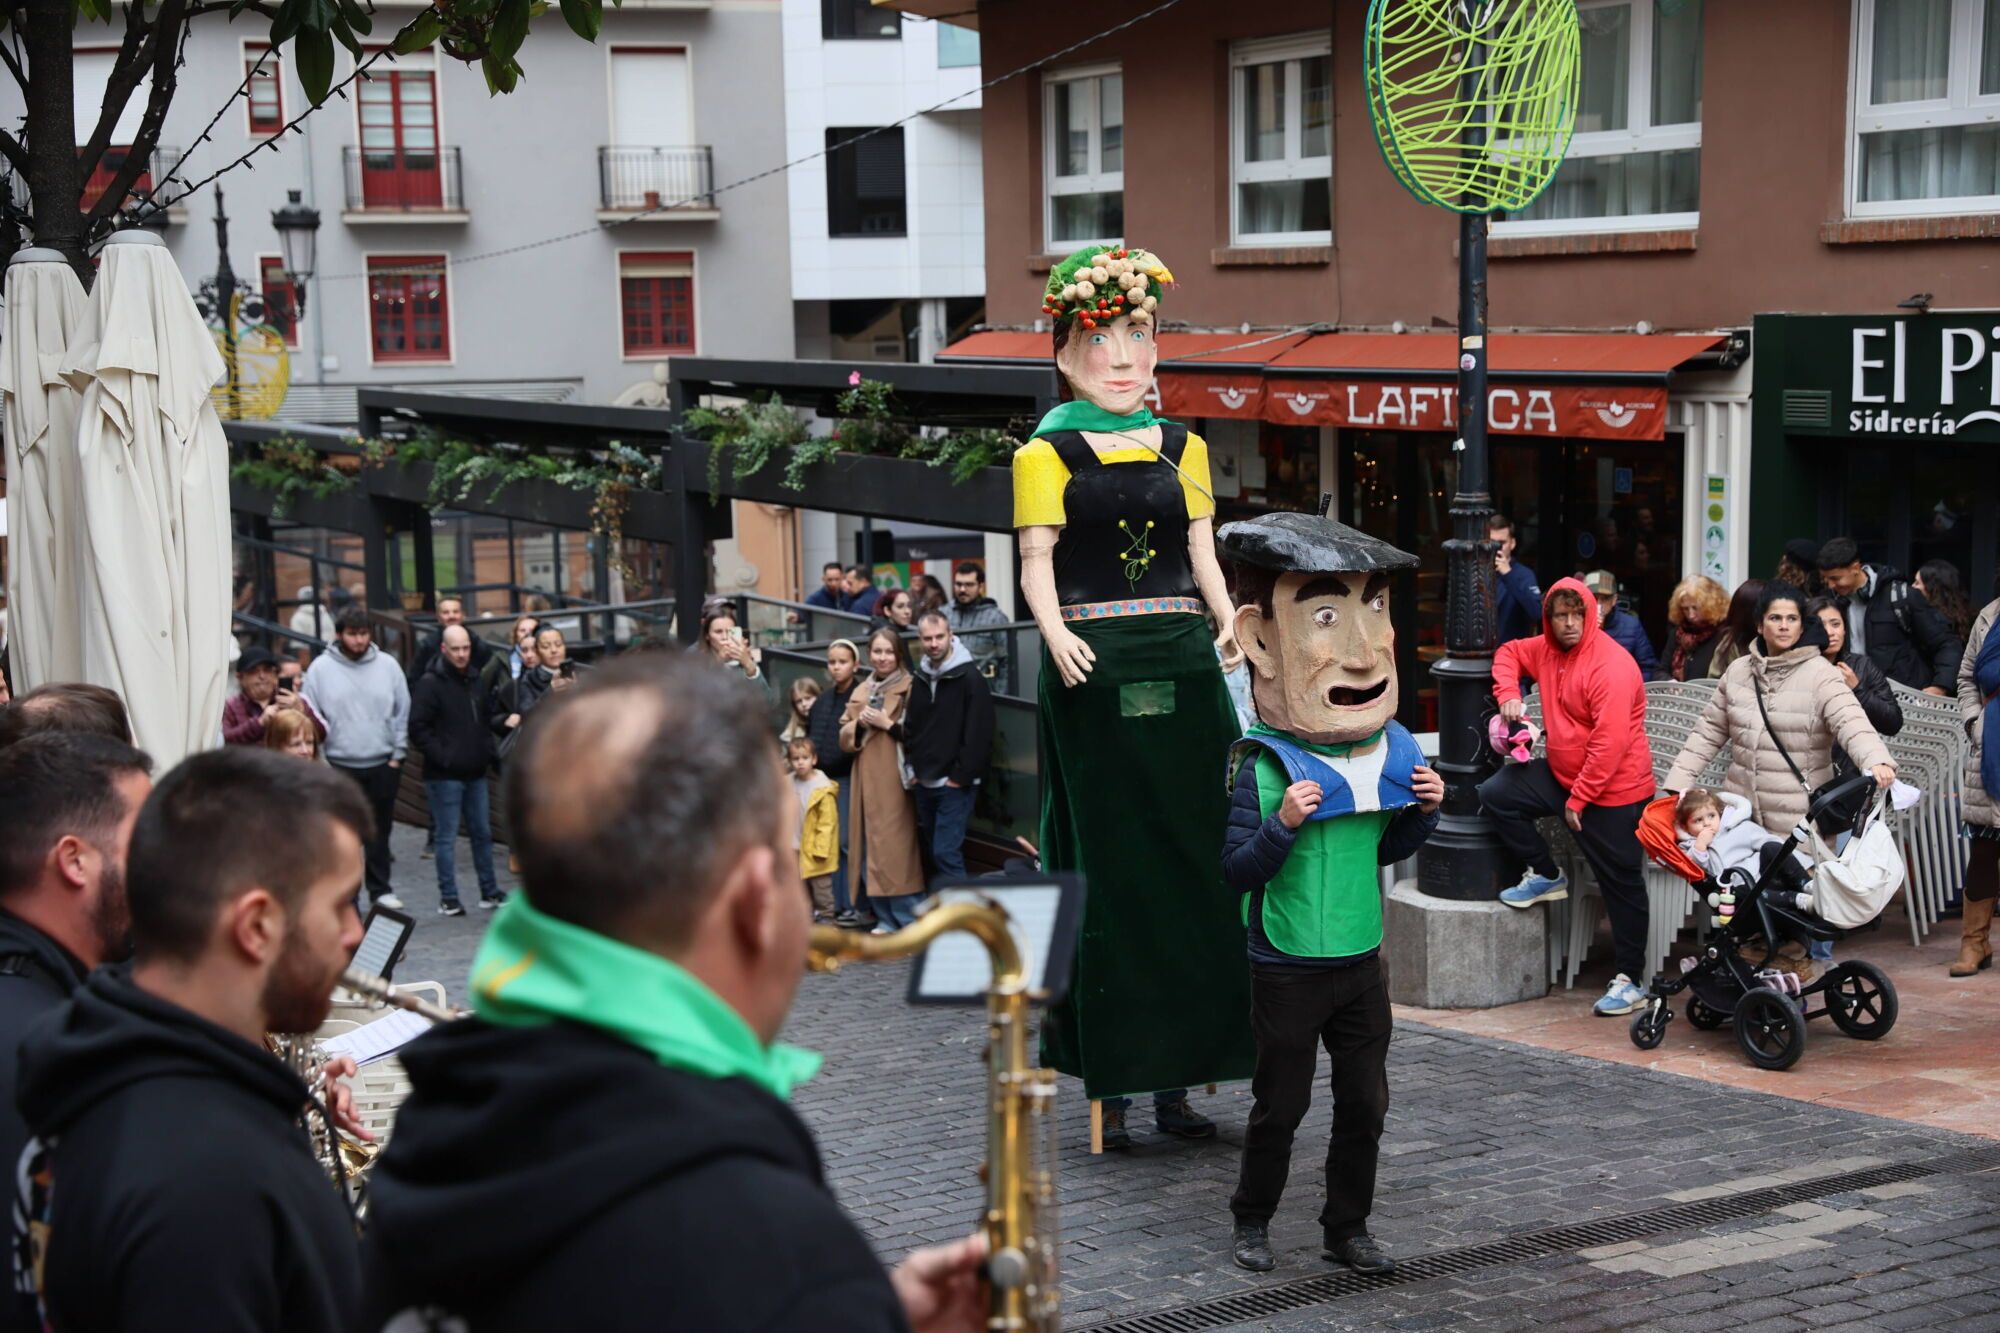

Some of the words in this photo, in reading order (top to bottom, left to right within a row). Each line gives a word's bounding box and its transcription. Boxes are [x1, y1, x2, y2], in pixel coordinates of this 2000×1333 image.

[1851, 320, 1906, 403] El
[1940, 326, 2000, 406] Pi
[1347, 385, 1557, 432] LAFICA
[1849, 409, 1957, 435] Sidrería
